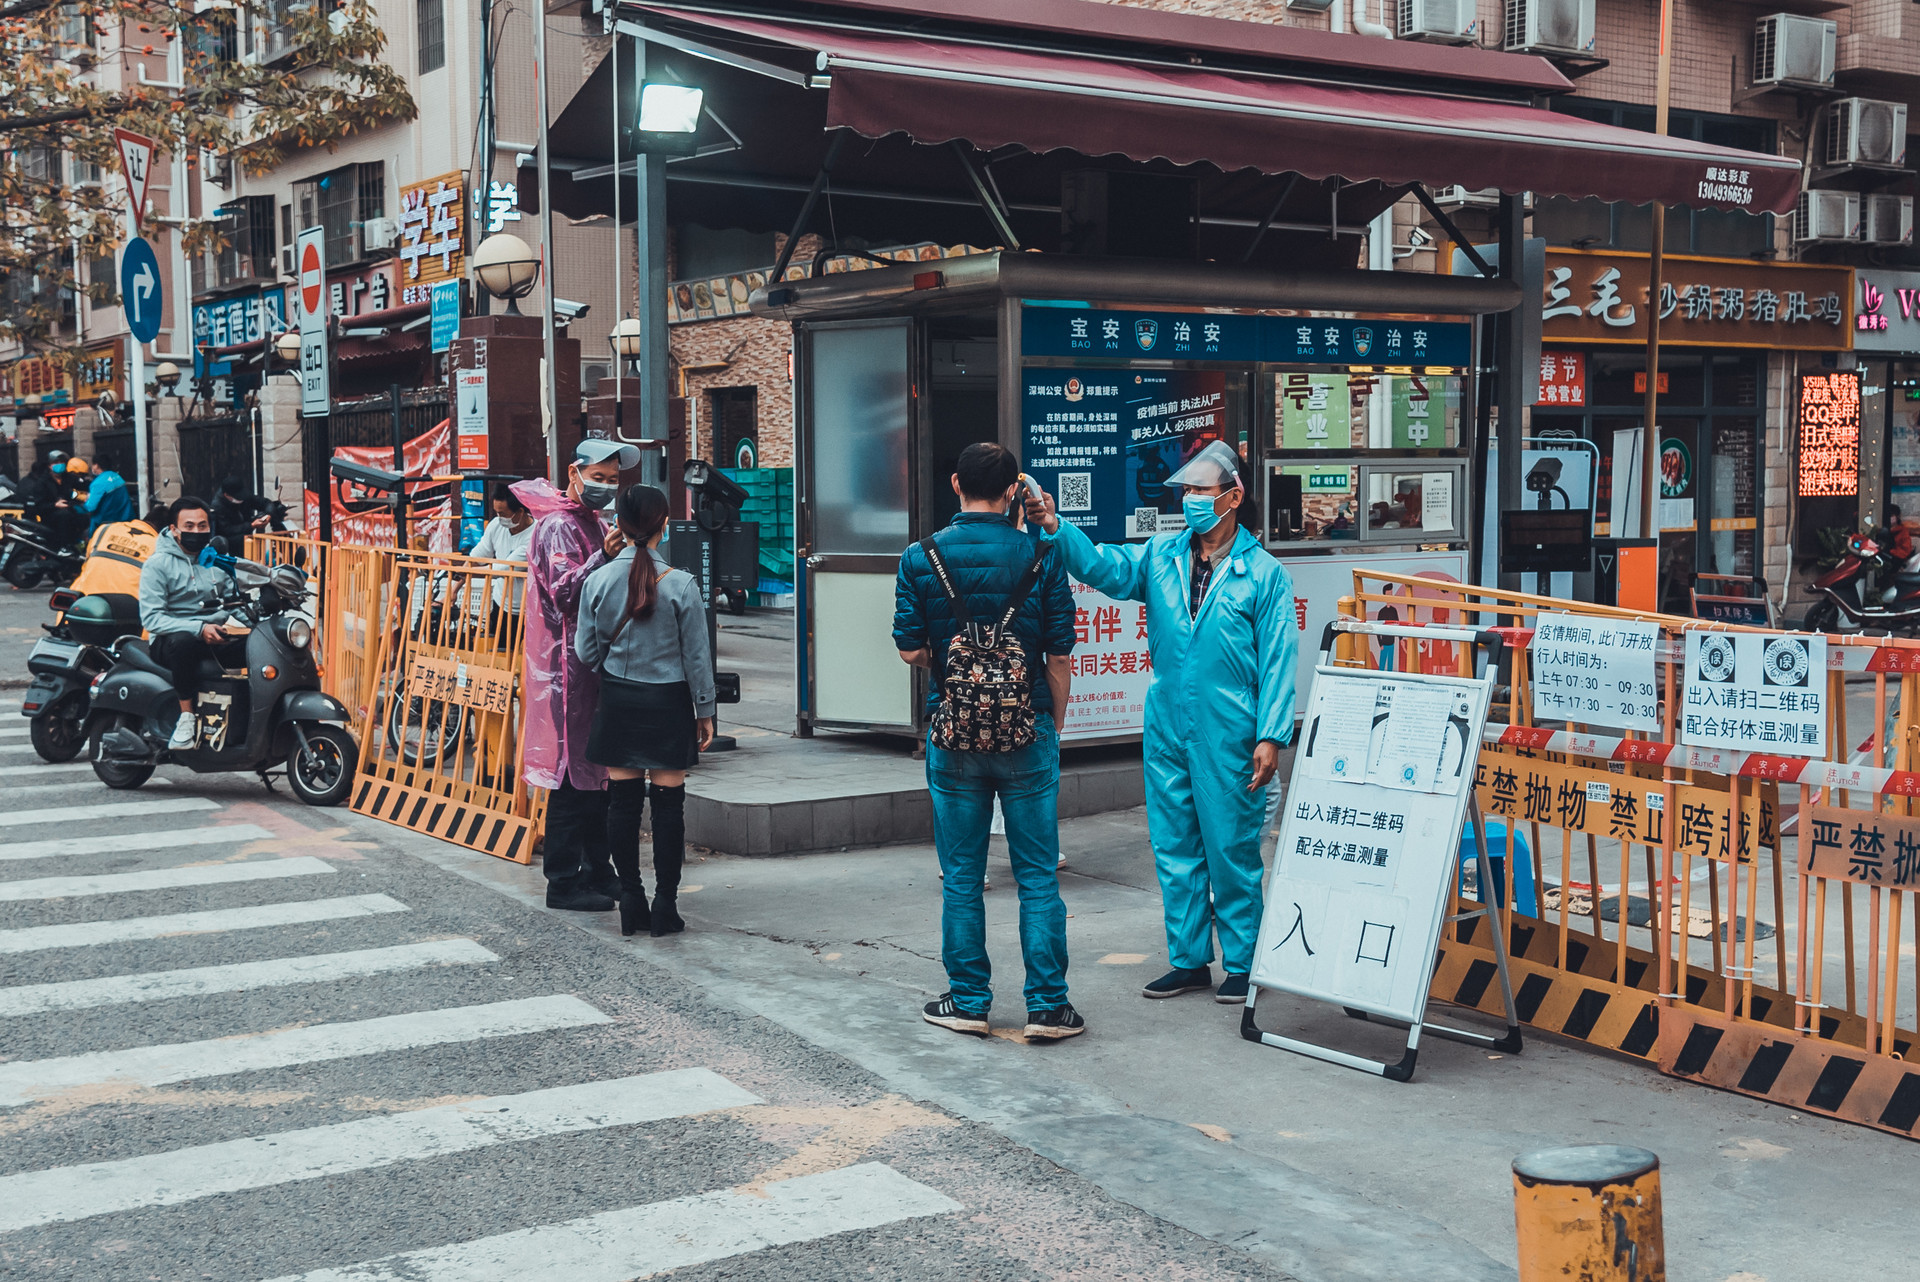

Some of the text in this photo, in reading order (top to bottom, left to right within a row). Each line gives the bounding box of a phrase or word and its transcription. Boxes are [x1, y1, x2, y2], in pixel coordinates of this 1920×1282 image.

[129, 148, 144, 182] 让
[1698, 180, 1753, 205] 13049366536
[400, 181, 460, 279] 学车
[1542, 267, 1636, 327] 三毛
[1898, 288, 1920, 319] V
[1071, 318, 1221, 342] 宝安 治安
[1297, 326, 1428, 348] 宝安 治安
[305, 344, 322, 372] 出口
[1071, 340, 1218, 352] BAO AN ZHI AN
[1297, 347, 1426, 358] BAO AN ZHI AN
[1540, 355, 1577, 382] 春节
[307, 377, 321, 392] EXIT
[1028, 385, 1119, 396] 深圳公安 郑重提示
[1137, 392, 1221, 419] 疫情当前 执法从严
[1306, 382, 1329, 449] 营业
[1805, 401, 1855, 425] QQ美甲
[1131, 413, 1215, 441] 事关人人 必须较真
[1539, 624, 1653, 651] 疫情期间，此门开放
[1537, 647, 1608, 670] 行人时间为：
[1881, 662, 1917, 670] SAFE
[412, 665, 508, 713] 严禁抛物 禁止跨越
[1538, 670, 1563, 687] 上午
[1566, 674, 1598, 690] 07:30
[1618, 680, 1653, 697] 09:30
[1078, 708, 1091, 717] 民主
[1096, 706, 1109, 715] 文明
[1539, 691, 1565, 708] 下午
[1568, 696, 1600, 711] 17:30
[1620, 702, 1656, 718] 20:30
[1688, 685, 1820, 714] 出入请扫二维码
[1515, 730, 1540, 741] 安全
[1686, 714, 1819, 745] 配合好体温测量
[1568, 744, 1595, 753] CAUTION
[1570, 737, 1596, 747] 注意
[1630, 744, 1657, 756] 安全
[1623, 751, 1652, 761] SAFE
[1690, 760, 1719, 769] CAUTION
[1691, 752, 1721, 763] 注意
[1759, 760, 1788, 773] 安全
[1751, 767, 1784, 777] SAFE
[1826, 776, 1859, 786] CAUTION
[1828, 768, 1861, 780] 注意
[1295, 802, 1405, 834] 出入请扫二维码
[1295, 836, 1389, 868] 配合体温测量
[1808, 819, 1920, 885] 严禁抛
[1272, 902, 1396, 967] 入口
